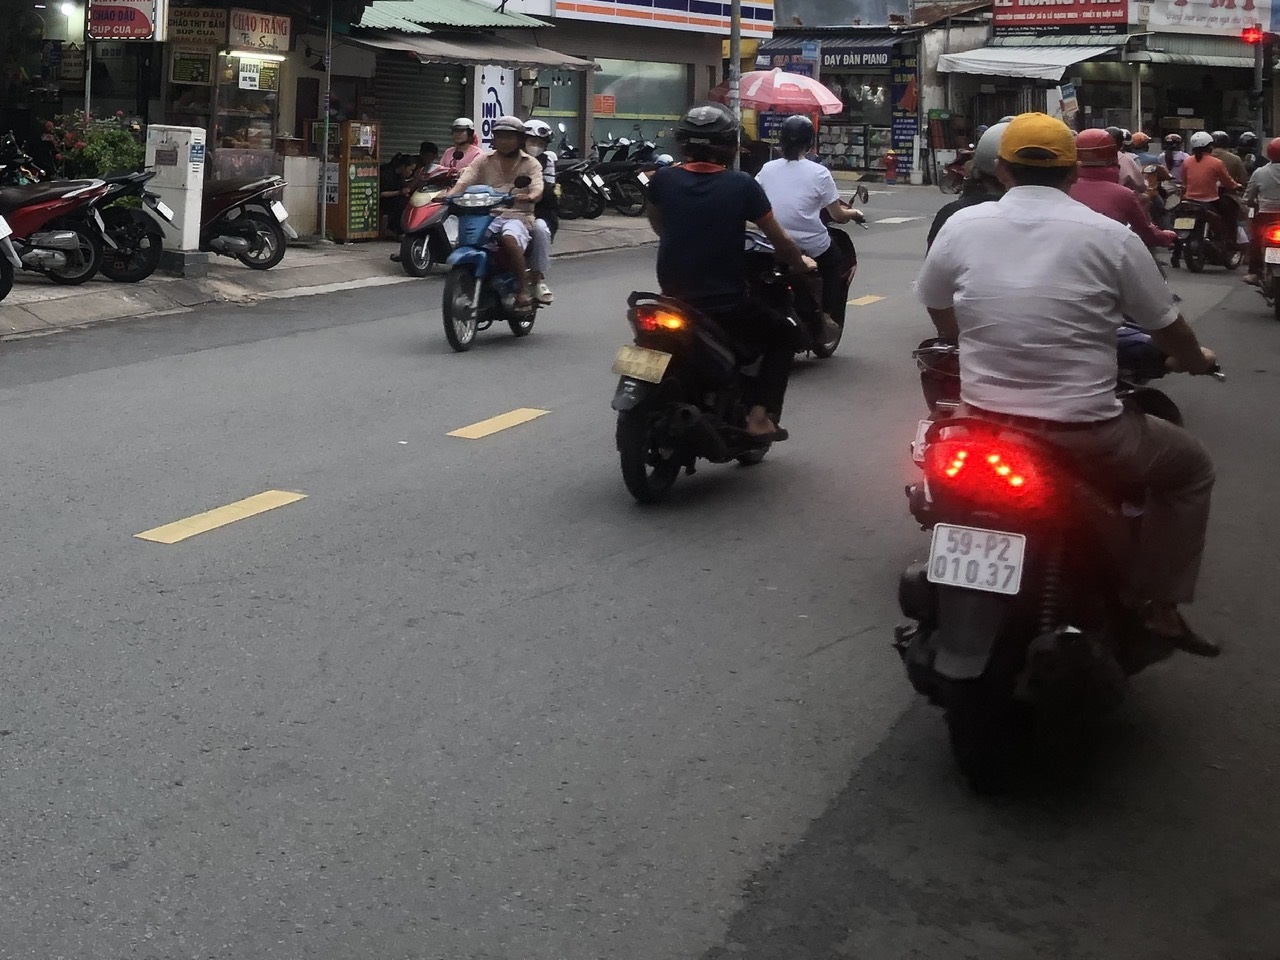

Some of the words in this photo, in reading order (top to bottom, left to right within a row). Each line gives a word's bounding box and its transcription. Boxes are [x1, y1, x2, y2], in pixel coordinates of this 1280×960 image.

[92, 24, 111, 34] SÚP
[112, 25, 131, 34] CUA
[233, 13, 257, 32] CHÁO
[824, 54, 842, 68] DẠY
[843, 51, 861, 66] ĐÀN
[862, 53, 888, 65] PIANO
[946, 529, 1011, 561] 59-P2
[933, 555, 1016, 589] 010.37
